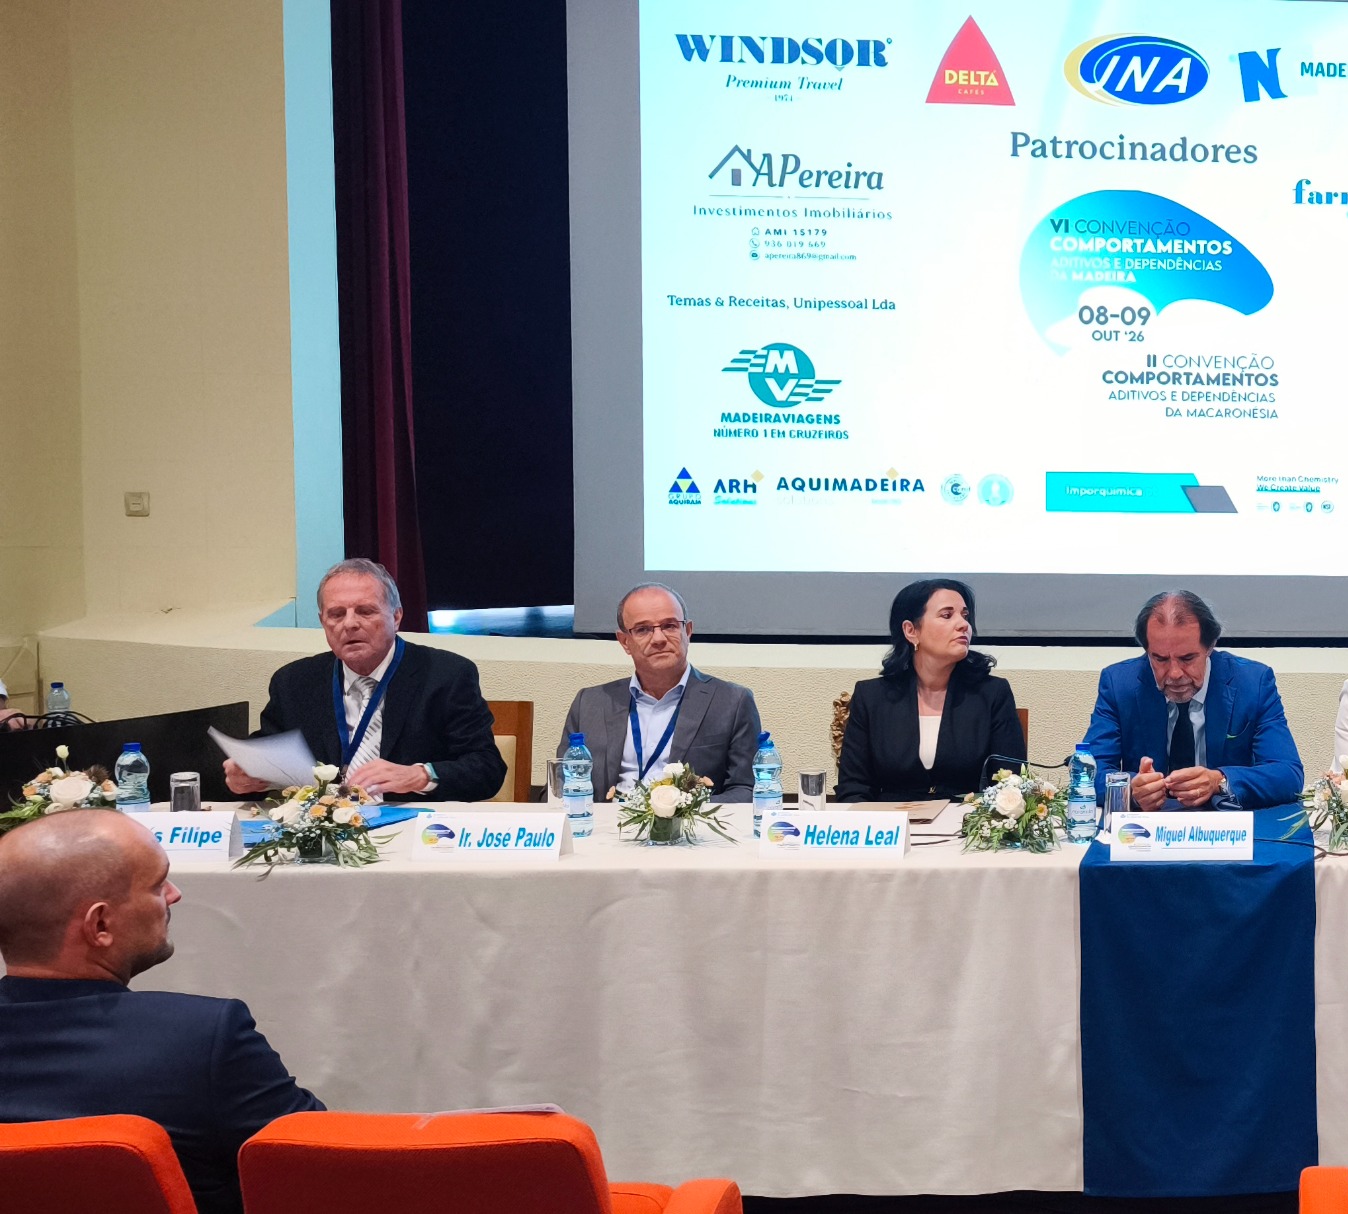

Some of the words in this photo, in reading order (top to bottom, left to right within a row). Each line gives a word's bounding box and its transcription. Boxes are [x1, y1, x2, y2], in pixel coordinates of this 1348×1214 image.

[674, 33, 889, 69] WINDSOR
[725, 74, 792, 90] Premium
[798, 76, 843, 91] Travel
[944, 69, 999, 87] DELTA
[1098, 55, 1192, 94] INA
[1010, 131, 1258, 164] Patrocinadores
[693, 204, 798, 218] Investimentos
[804, 206, 893, 220] Imobiliários
[764, 228, 787, 236] AMI
[793, 228, 828, 237] 15179
[1049, 218, 1070, 234] VI
[1074, 218, 1191, 239] CONVENÇÃO
[1050, 235, 1233, 255] COMPORTAMENTOS
[1051, 256, 1111, 270] ADITIVOS
[1113, 257, 1122, 270] E
[1125, 256, 1223, 271] DEPENDÊNCIAS
[1072, 271, 1137, 283] MADEIRA
[667, 294, 711, 307] Temas
[715, 296, 725, 307] &
[728, 295, 790, 310] Receitas,
[793, 297, 868, 311] Unipessoal
[872, 298, 896, 310] Lda
[1078, 305, 1151, 326] 08-09
[1091, 330, 1120, 342] OUT
[1146, 354, 1157, 368] II
[1162, 352, 1275, 371] CONVENÇÃO
[1102, 370, 1279, 387] COMPORTAMENTOS
[1108, 390, 1167, 401] ADITIVOS
[1171, 390, 1178, 401] E
[1181, 389, 1276, 403] DEPENDÊNCIAS
[720, 412, 841, 425] MADEIRAVIAGENS
[1165, 407, 1183, 418] DA
[1186, 406, 1279, 419] MACARONÉSIA
[713, 425, 759, 439] NÚMERO
[763, 428, 768, 438] 1
[770, 428, 786, 439] EM
[789, 429, 849, 440] CRUZEIROS
[713, 478, 757, 494] ARH
[776, 476, 925, 493] AQUIMADEIRA
[1297, 475, 1339, 484] Chemistry
[169, 826, 222, 847] Filipe
[458, 827, 472, 848] Ir.
[476, 827, 511, 848] José
[514, 827, 555, 848] Paulo
[803, 824, 860, 846] Helena
[864, 824, 900, 846] Leal
[1154, 825, 1186, 847] Miguel
[1187, 825, 1247, 846] Albuquerque
